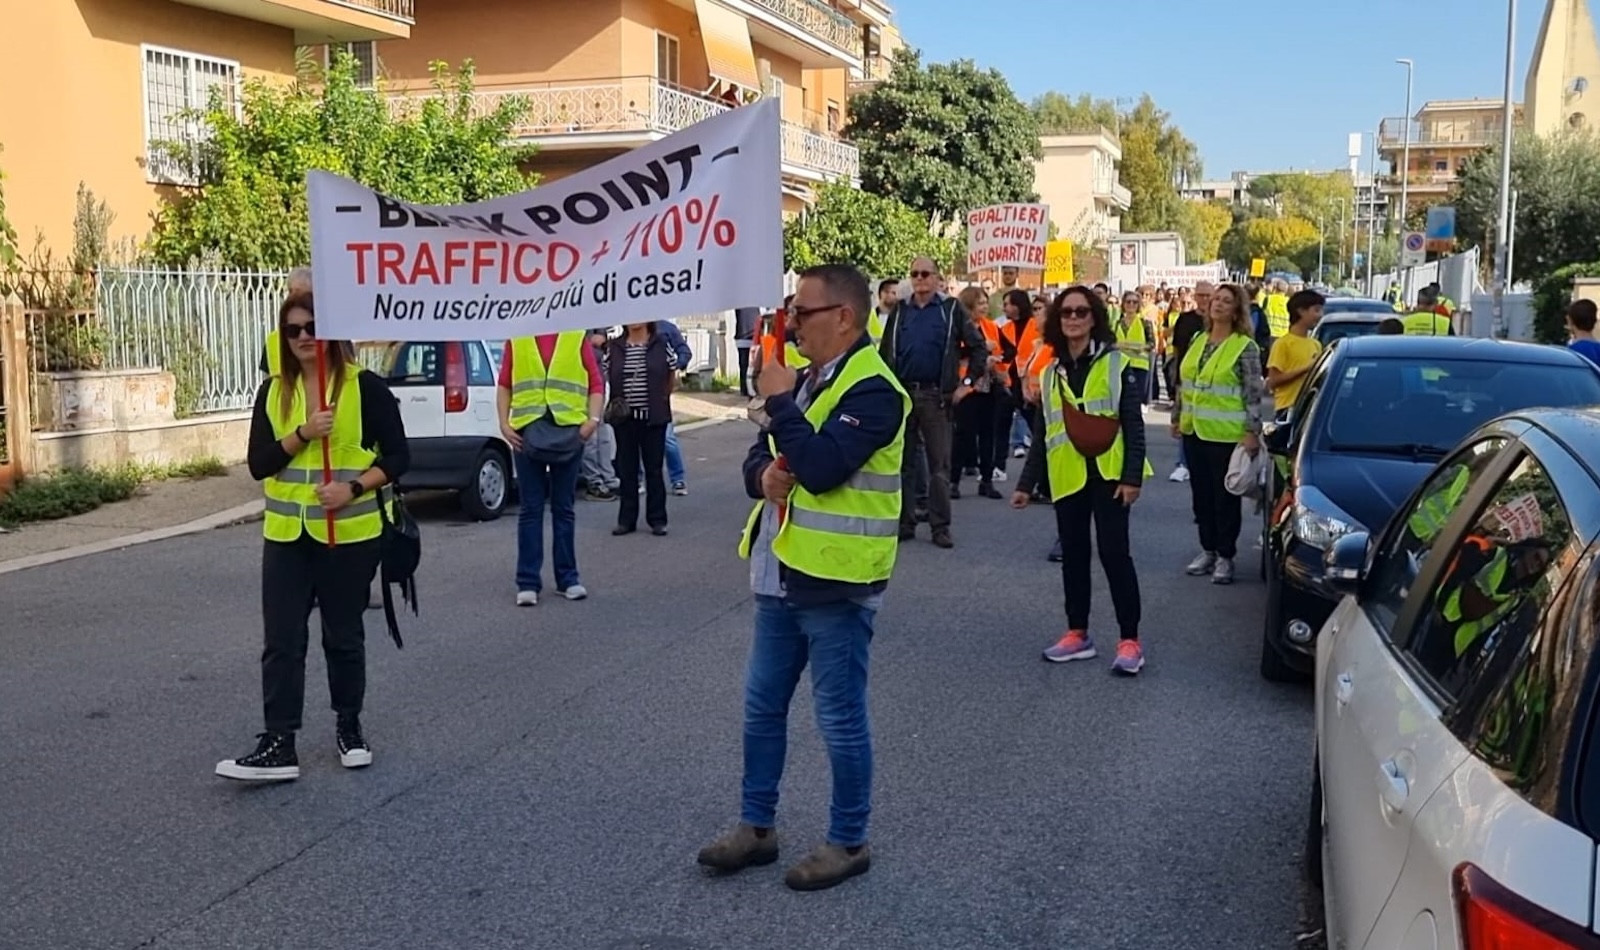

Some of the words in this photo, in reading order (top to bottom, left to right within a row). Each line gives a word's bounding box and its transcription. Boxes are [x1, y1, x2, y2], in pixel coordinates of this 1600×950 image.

[524, 145, 701, 234] POINT
[969, 206, 1045, 226] GUALTIERI
[975, 228, 985, 242] CI
[992, 226, 1037, 242] CHIUDI
[346, 241, 580, 285] TRAFFICO
[619, 194, 736, 262] 110%
[970, 249, 986, 268] NEI
[988, 243, 1046, 265] QUARTIERI
[374, 293, 424, 321] Non
[433, 293, 545, 320] usciremo
[546, 279, 585, 319] più
[593, 273, 616, 305] di
[627, 259, 705, 300] casa!
